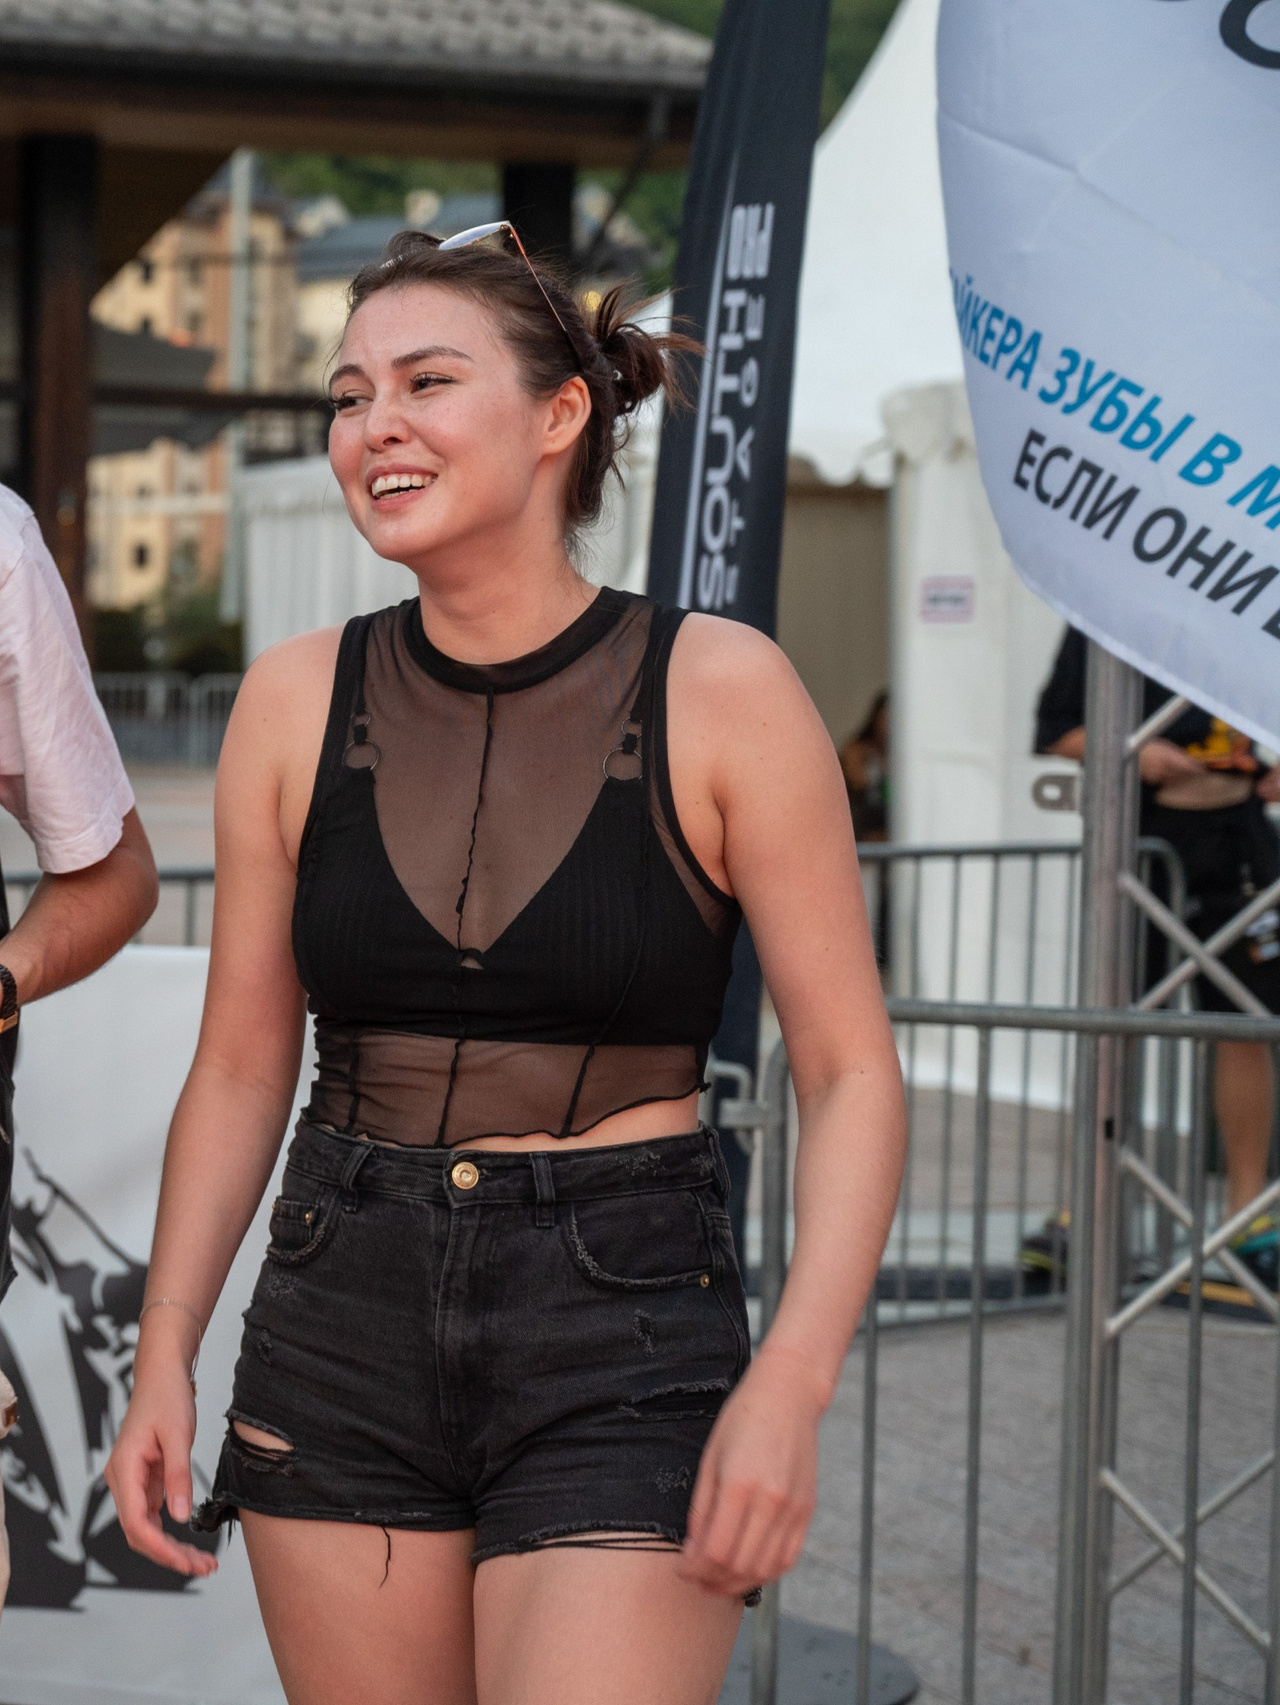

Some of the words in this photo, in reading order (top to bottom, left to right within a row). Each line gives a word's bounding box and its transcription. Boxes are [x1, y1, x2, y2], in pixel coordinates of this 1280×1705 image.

[697, 288, 747, 611] SOUTH
[724, 294, 766, 602] STAGE
[1013, 427, 1141, 541] ЕСЛИ
[1133, 506, 1280, 616] ОНИ
[1038, 347, 1196, 463] ЗУБЫ
[1178, 432, 1243, 487] В
